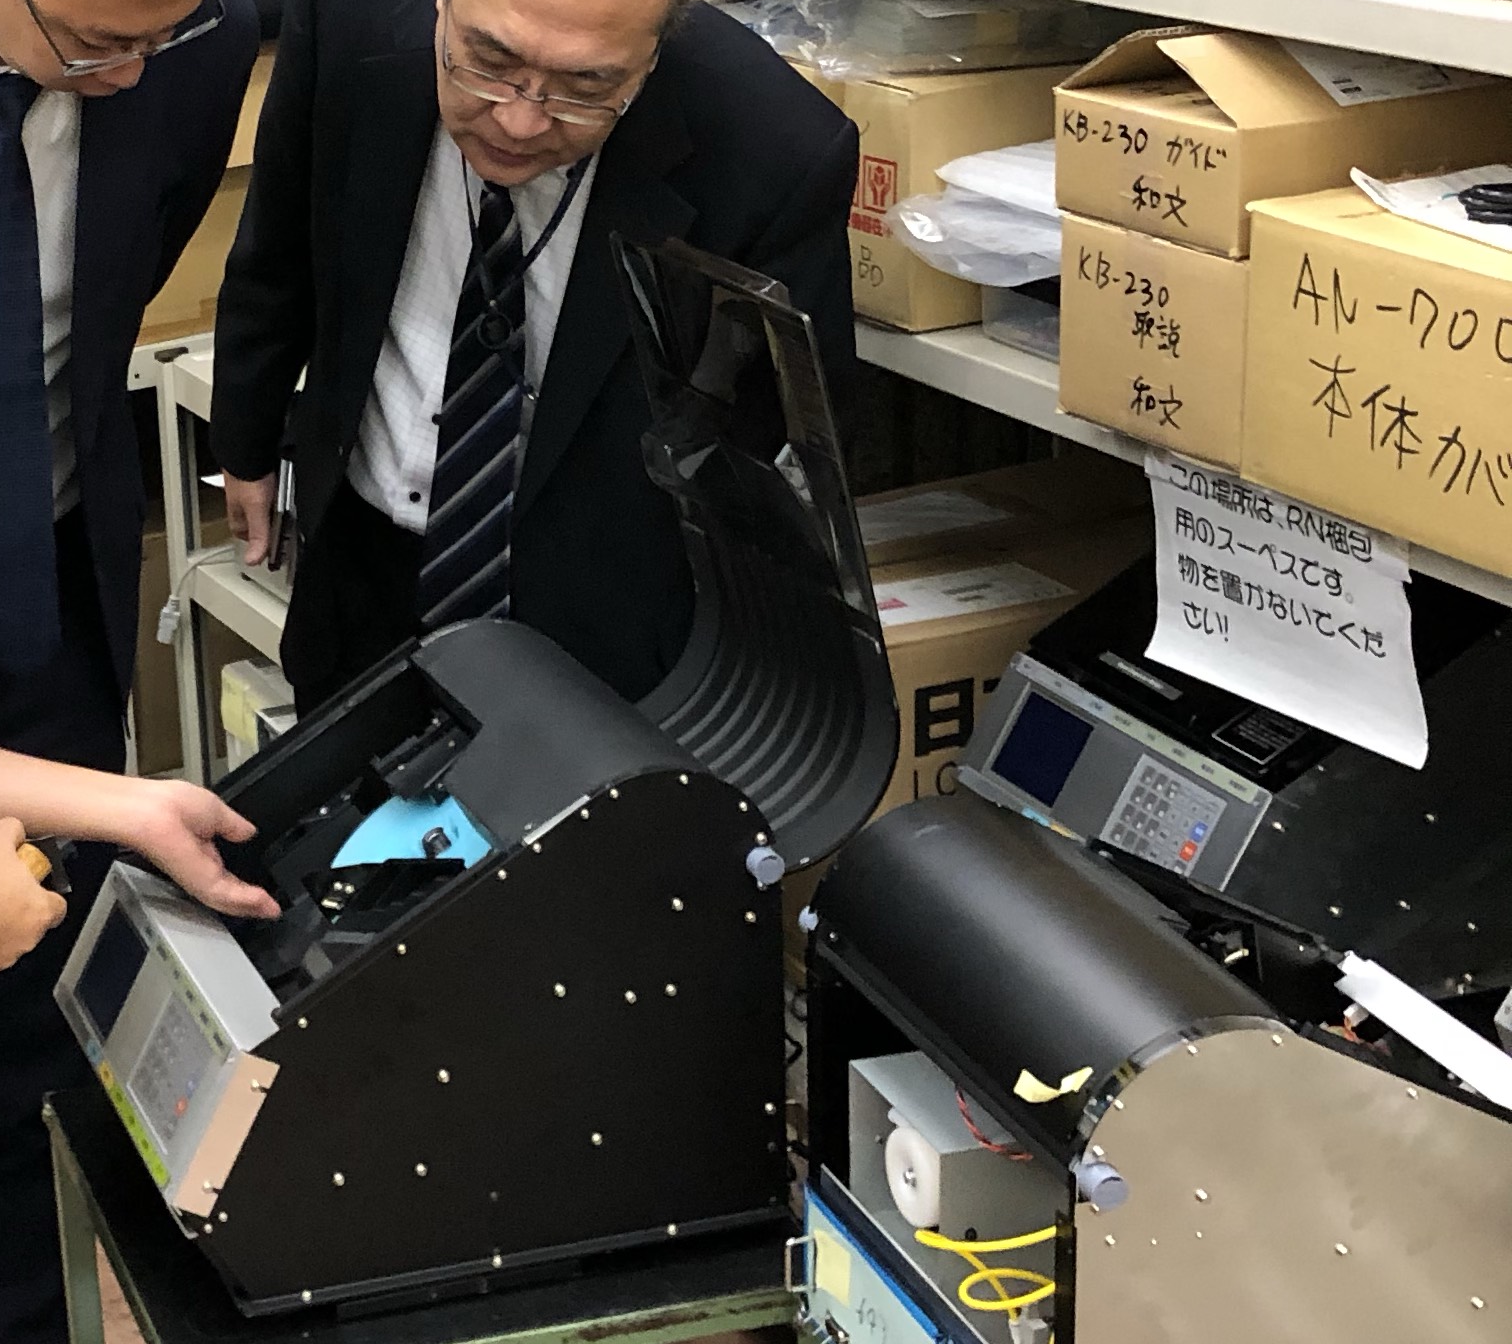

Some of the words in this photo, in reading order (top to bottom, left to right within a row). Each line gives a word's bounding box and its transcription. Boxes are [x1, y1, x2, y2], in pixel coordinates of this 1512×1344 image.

[1063, 108, 1148, 154] KB-230
[1166, 134, 1227, 171] ガイド
[1132, 175, 1189, 228] 和文
[1079, 246, 1169, 307] KB-230
[1131, 376, 1183, 429] 和文
[1170, 463, 1372, 562] この場所は、RN梱包
